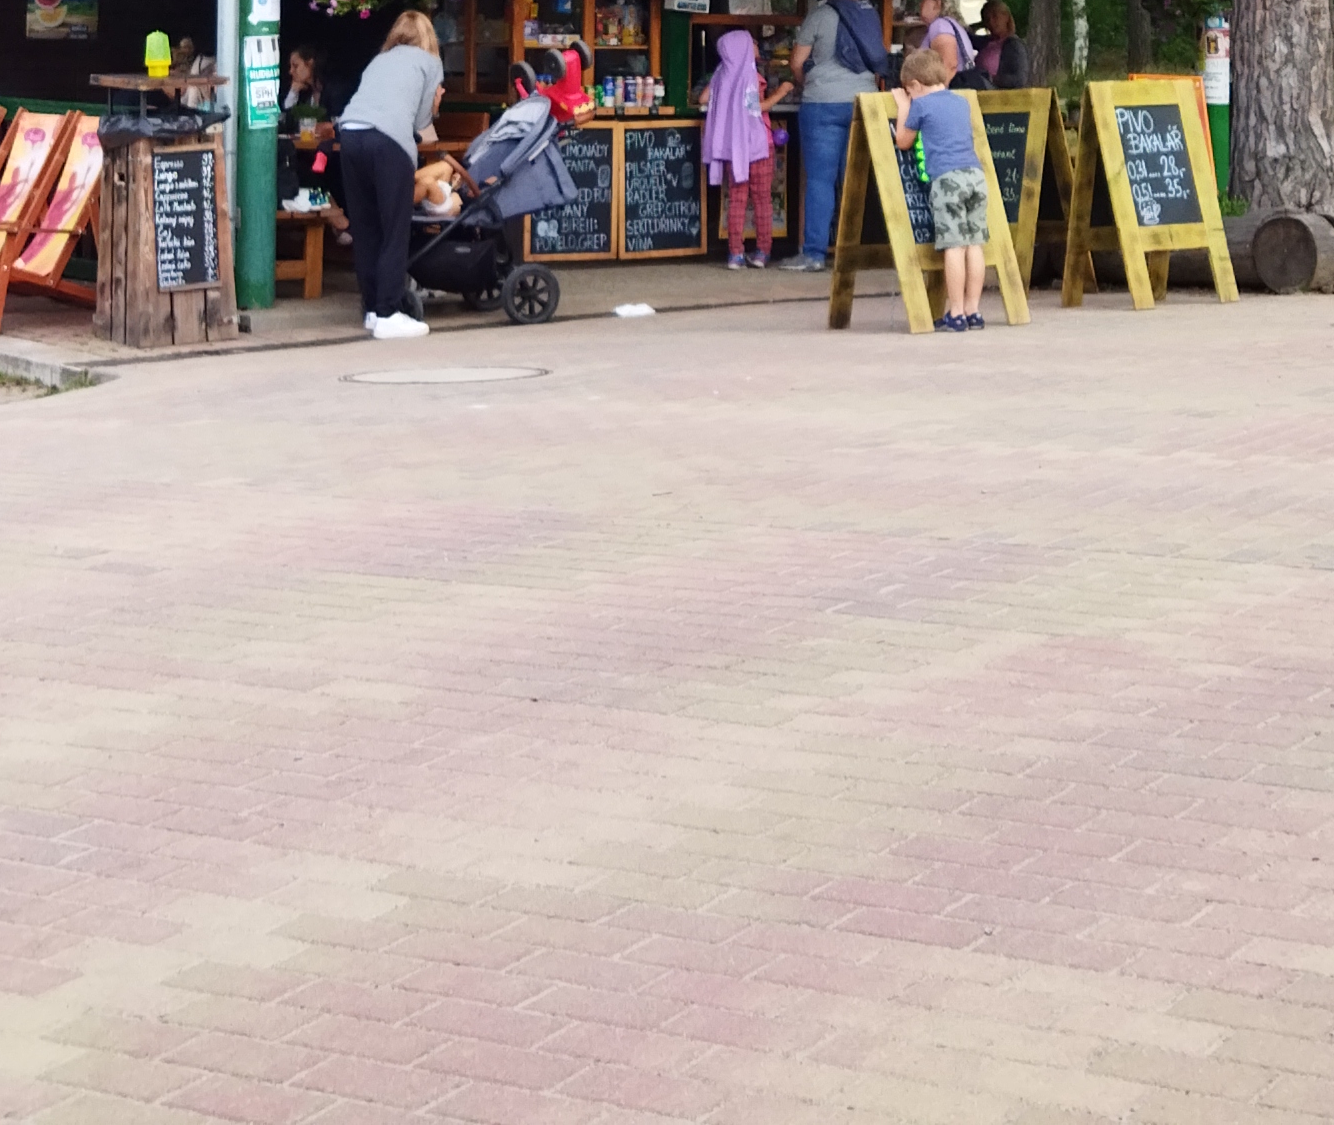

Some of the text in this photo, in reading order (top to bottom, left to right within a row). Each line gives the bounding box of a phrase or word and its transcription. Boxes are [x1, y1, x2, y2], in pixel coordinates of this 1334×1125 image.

[1115, 108, 1154, 134] PIVO
[625, 131, 655, 151] PIVO
[565, 159, 597, 172] FANTA
